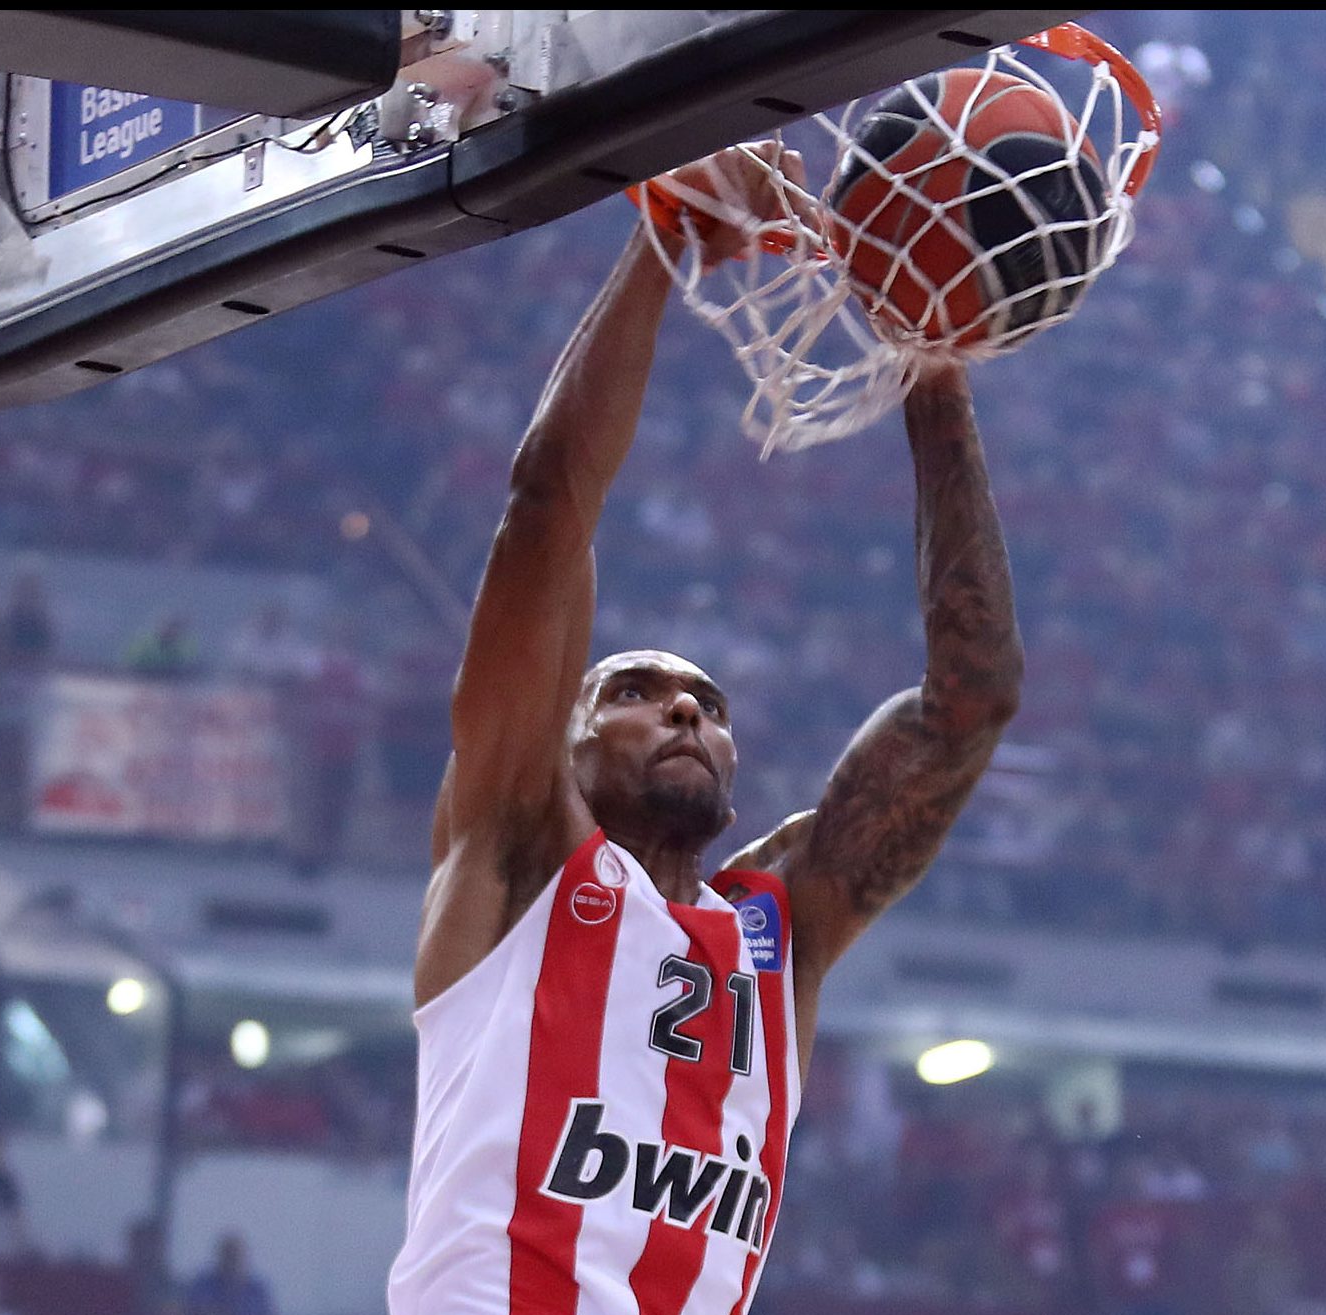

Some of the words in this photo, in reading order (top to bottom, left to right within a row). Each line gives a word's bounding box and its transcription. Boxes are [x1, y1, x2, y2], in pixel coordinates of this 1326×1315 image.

[80, 107, 163, 165] League
[81, 86, 149, 125] Bas
[649, 953, 757, 1076] 21
[546, 1102, 769, 1250] bwin
